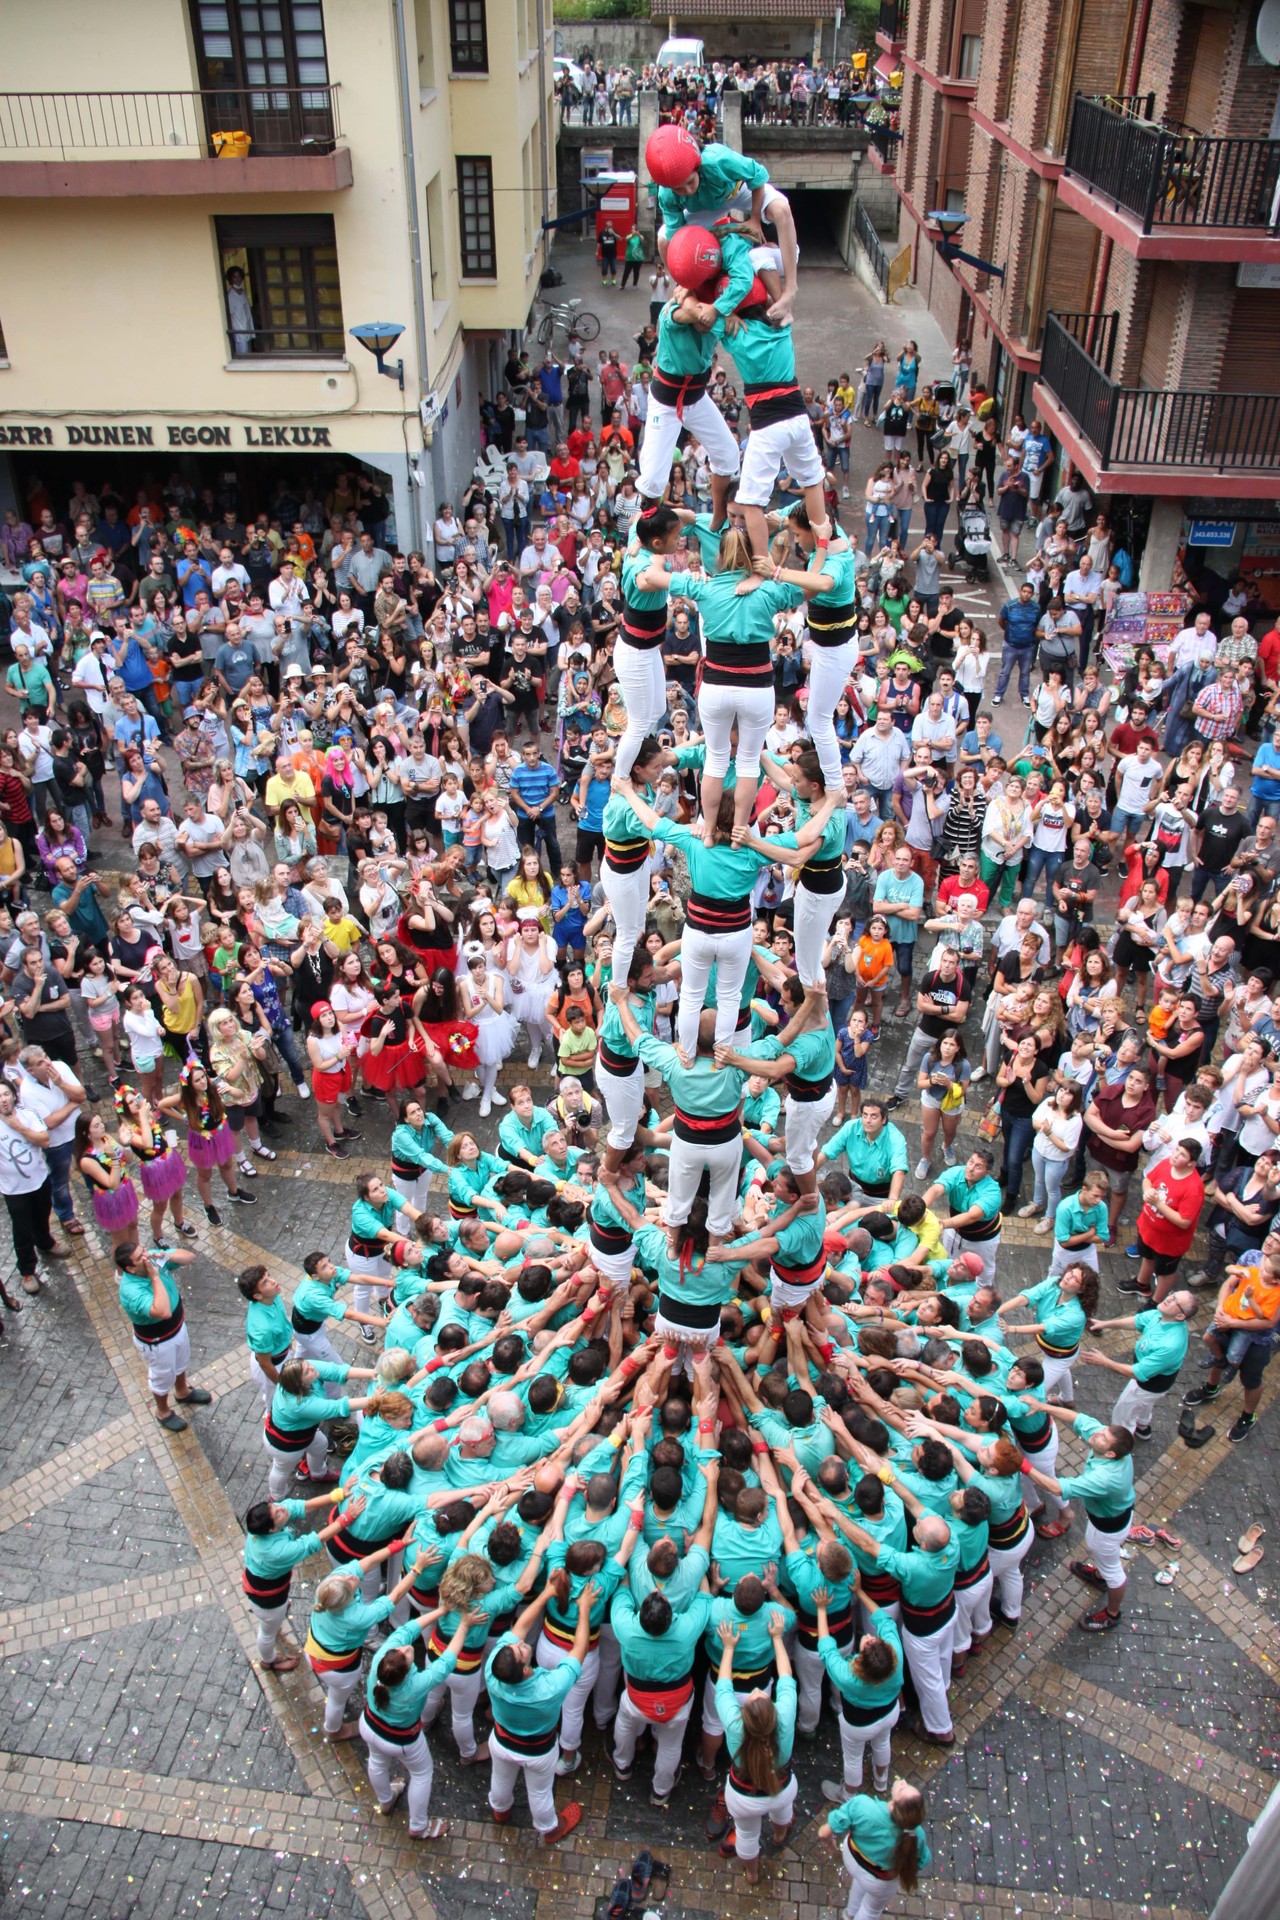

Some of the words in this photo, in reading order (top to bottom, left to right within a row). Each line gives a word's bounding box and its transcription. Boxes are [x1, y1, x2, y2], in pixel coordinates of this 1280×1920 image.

[66, 426, 154, 445] DUNEN
[167, 426, 231, 446] EGON
[244, 426, 332, 447] LEKUA
